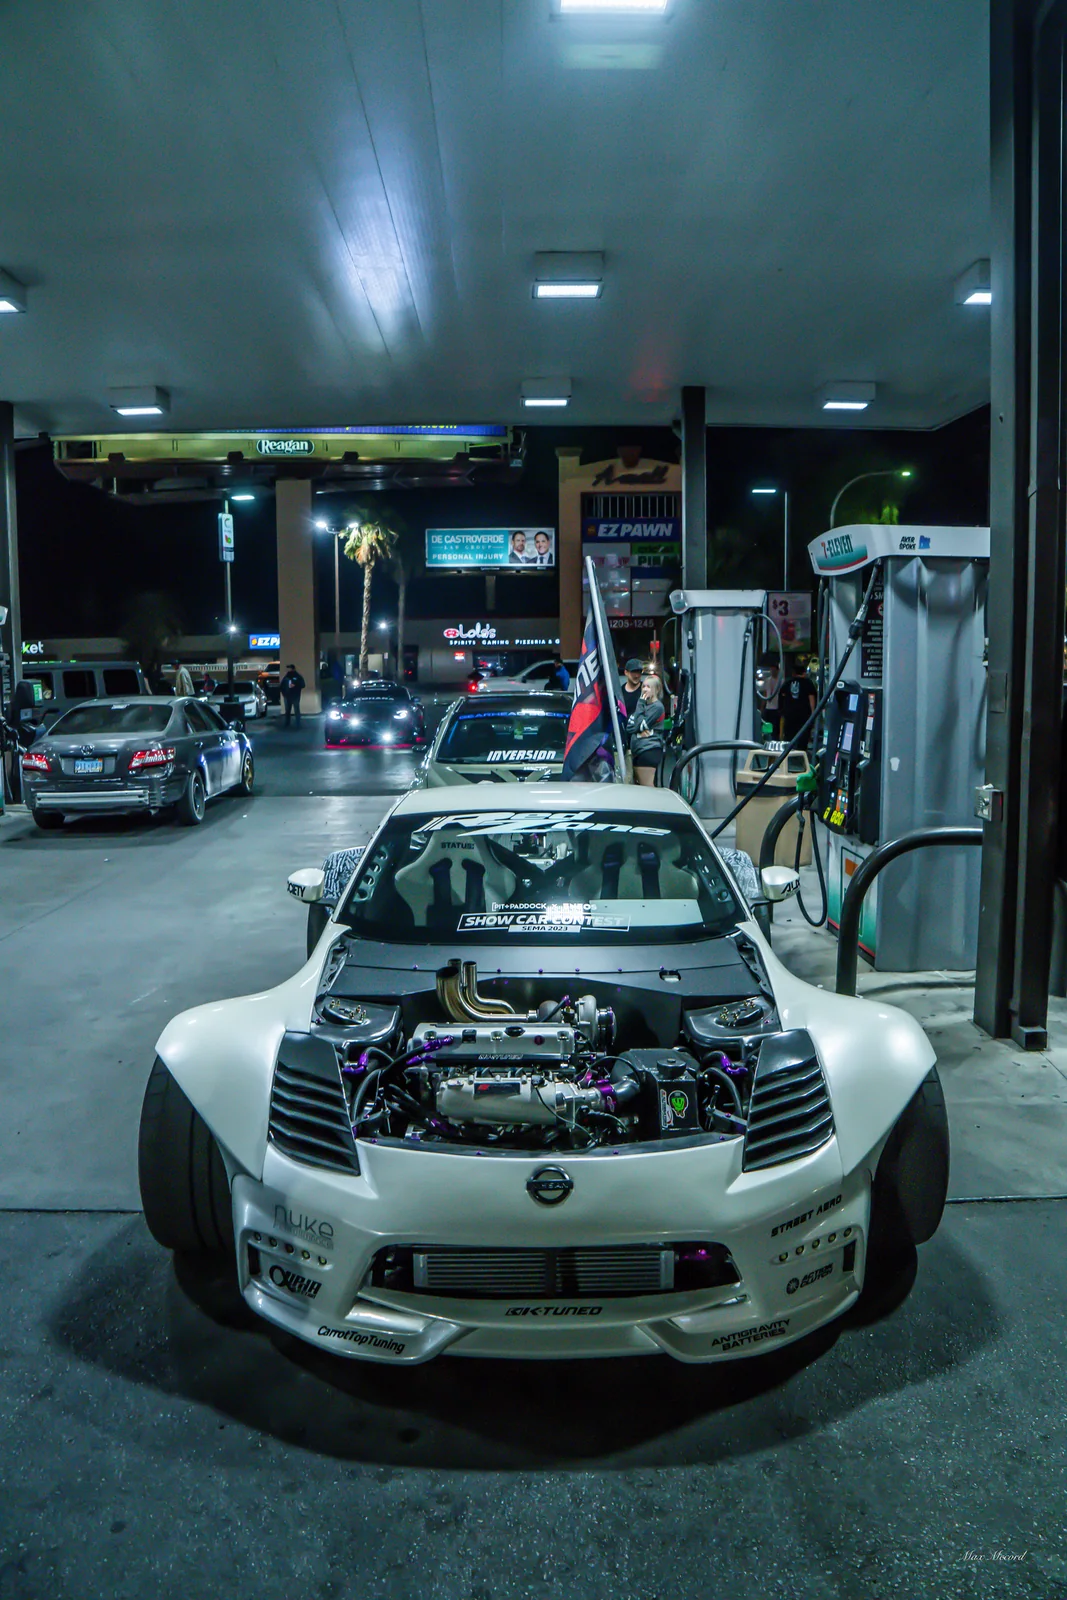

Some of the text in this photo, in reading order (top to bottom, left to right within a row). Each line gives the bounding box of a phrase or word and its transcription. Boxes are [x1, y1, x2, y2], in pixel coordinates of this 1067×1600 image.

[261, 440, 309, 454] Reagan
[431, 535, 504, 544] DE CASTROVERDE
[487, 750, 557, 762] INVERSION
[465, 915, 626, 927] SHOW CAR CONTEST
[771, 1194, 842, 1238] STREET AERO
[318, 1326, 405, 1354] CarrotTopTuning
[711, 1319, 790, 1347] ANTIGRAVITY
[722, 1327, 786, 1351] BATTERIES
